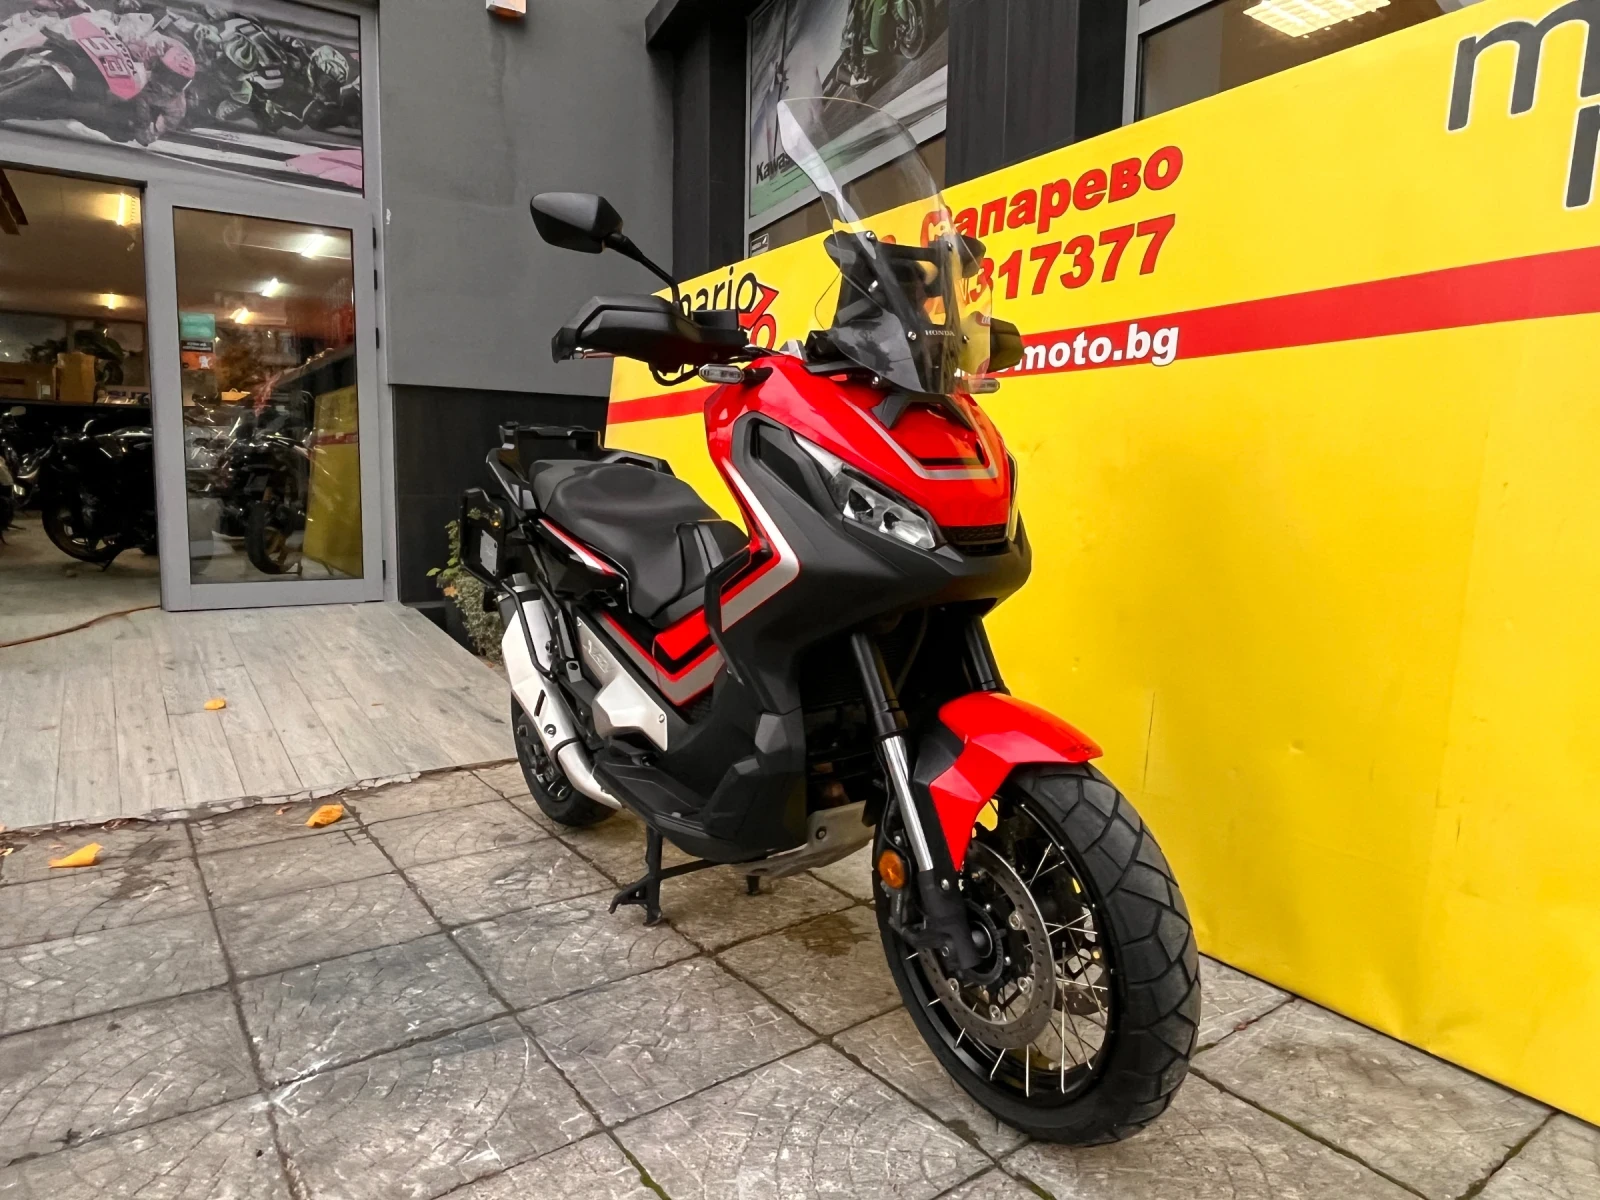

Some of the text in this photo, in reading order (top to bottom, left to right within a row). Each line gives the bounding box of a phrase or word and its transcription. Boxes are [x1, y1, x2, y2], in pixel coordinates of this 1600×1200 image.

[755, 153, 792, 184] Kawas
[968, 213, 1177, 304] 317377
[924, 329, 956, 338] HONDA
[1000, 322, 1180, 367] moto.bg
